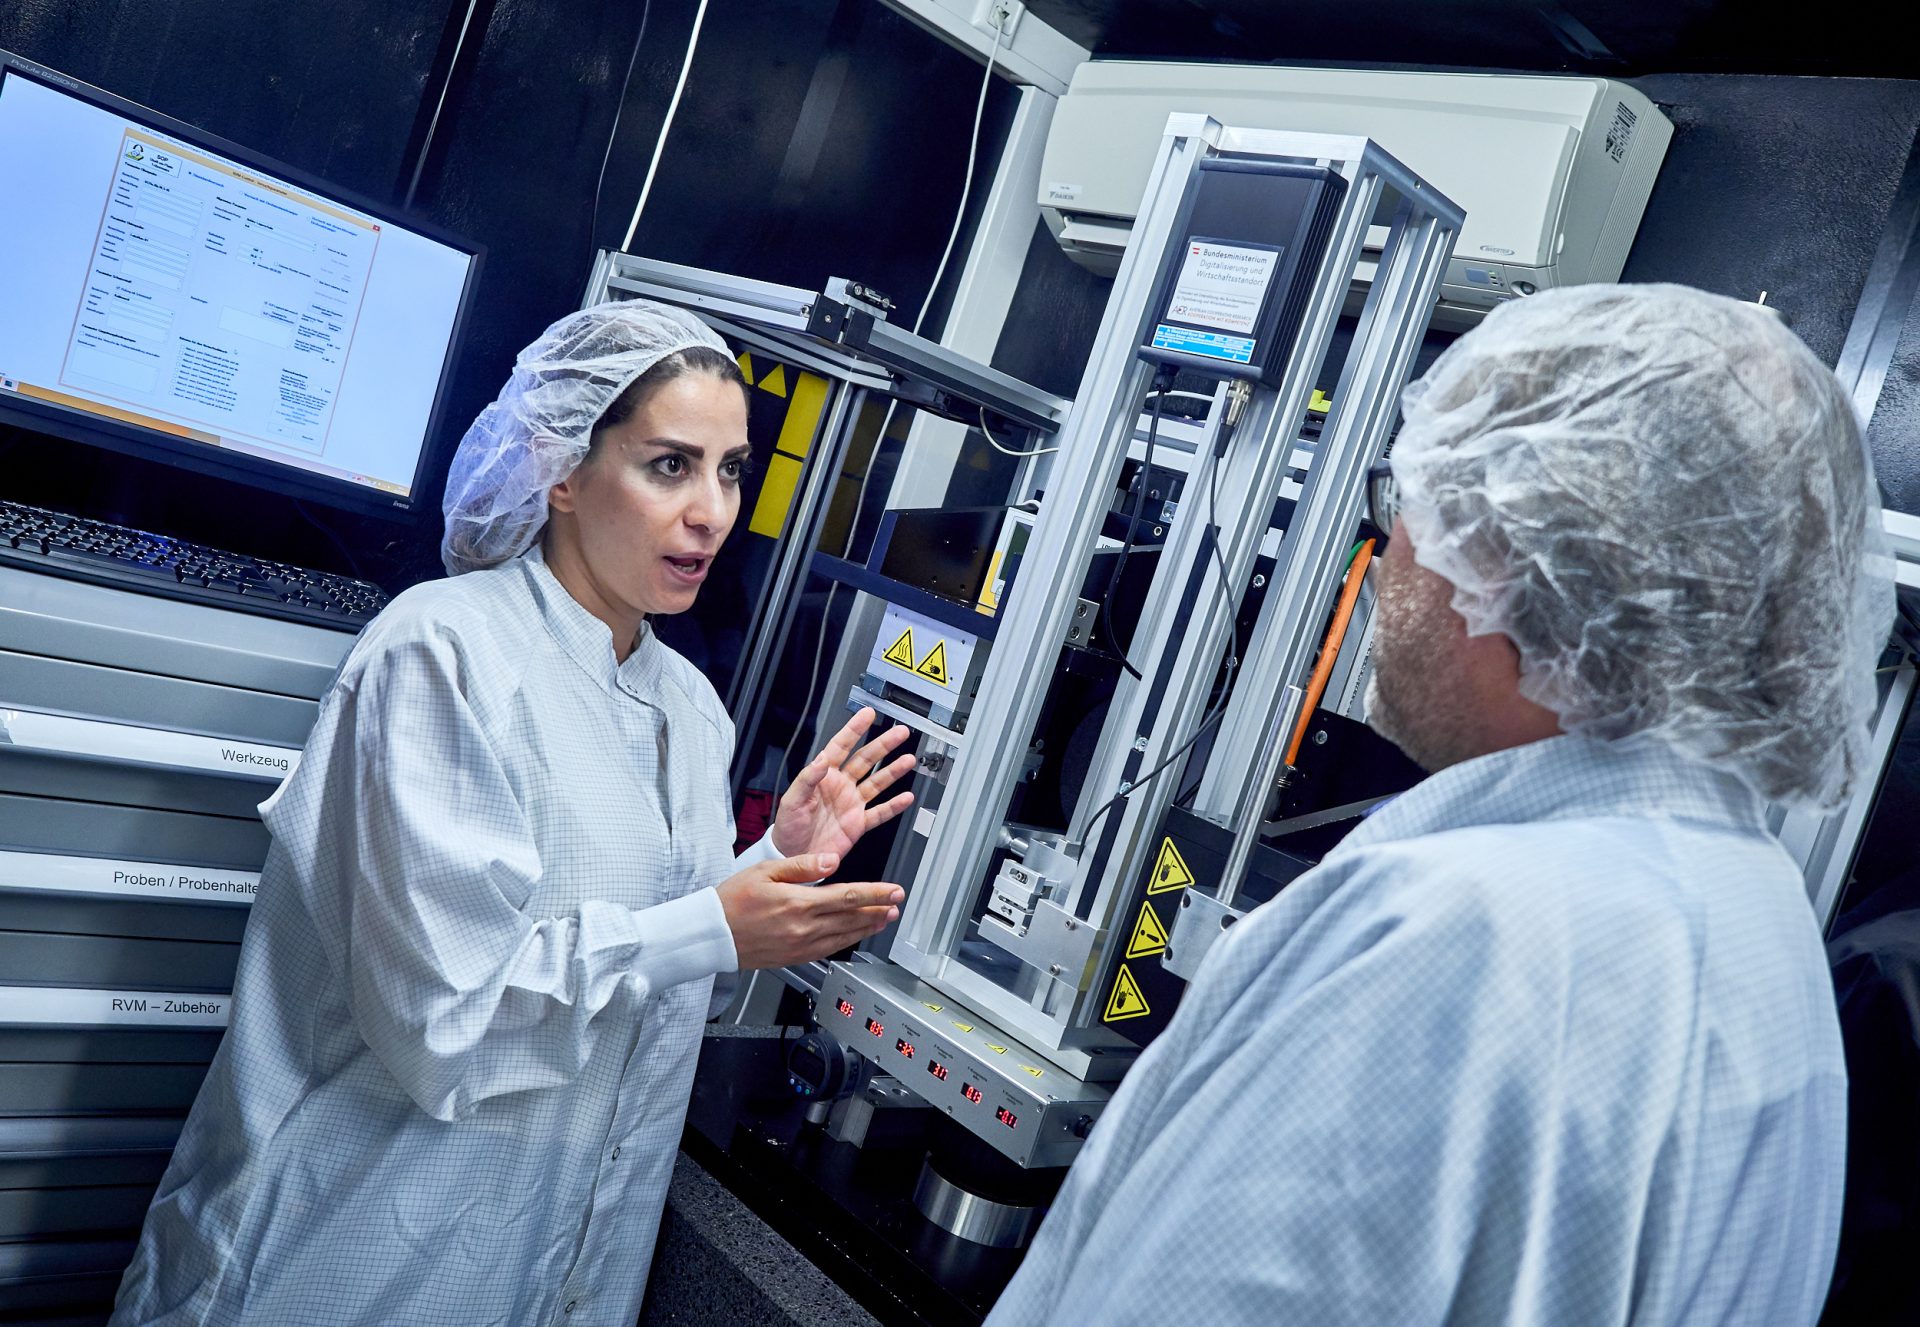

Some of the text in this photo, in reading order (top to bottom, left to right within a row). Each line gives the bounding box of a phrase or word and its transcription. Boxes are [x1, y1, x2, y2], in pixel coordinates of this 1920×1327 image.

[1203, 248, 1267, 264] Bundesministerium
[1199, 259, 1263, 275] Digitalisierung und
[1196, 270, 1264, 287] Wirtschaftsstandort
[221, 748, 289, 771] Werkzeug
[113, 871, 166, 887] Proben
[169, 876, 175, 888] /
[112, 998, 147, 1012] RVM
[164, 1000, 221, 1014] Zubehör
